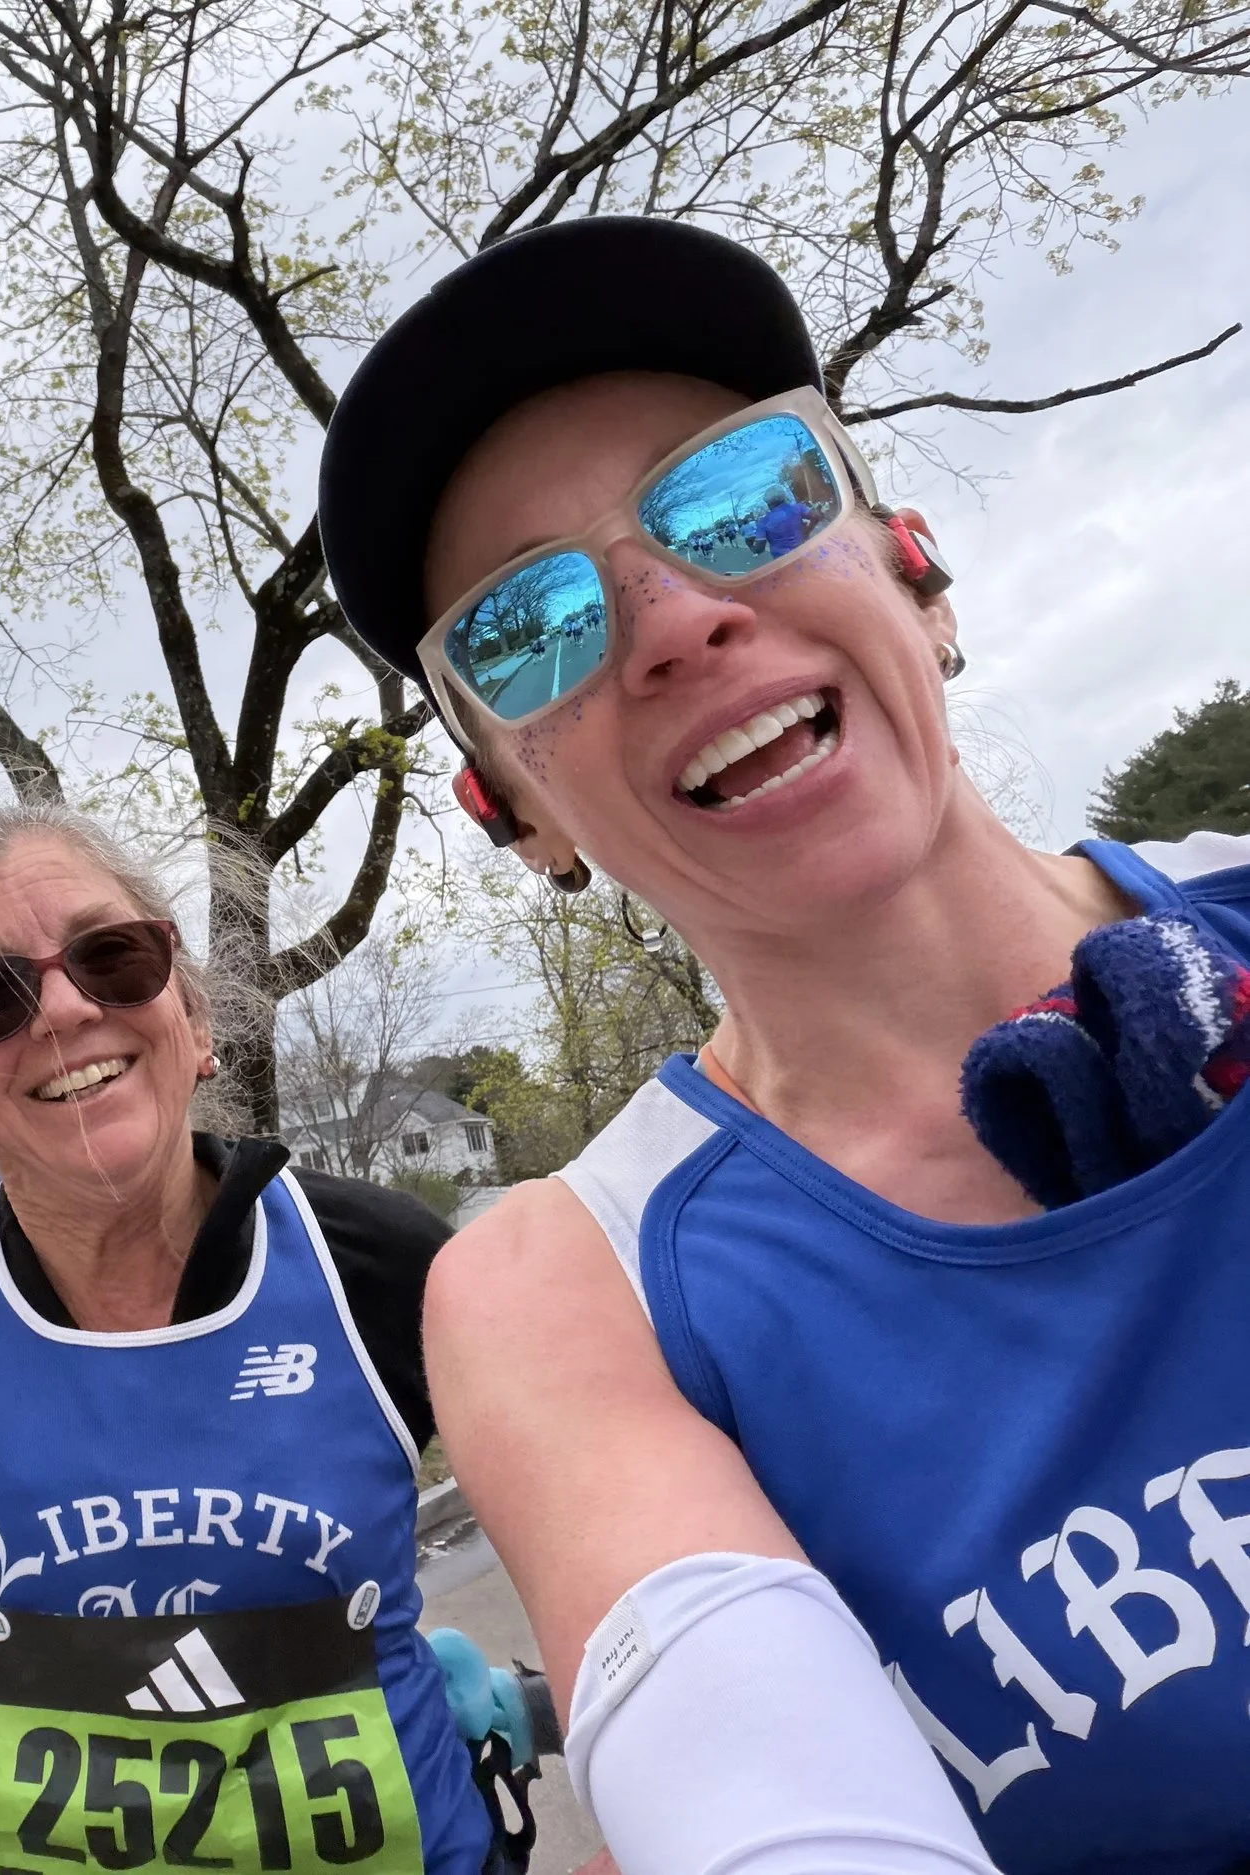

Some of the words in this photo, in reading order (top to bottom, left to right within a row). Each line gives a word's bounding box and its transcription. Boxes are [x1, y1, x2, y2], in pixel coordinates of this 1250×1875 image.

[230, 1343, 317, 1400] NB
[618, 1627, 634, 1646] run
[602, 1647, 618, 1669] free
[617, 1644, 638, 1668] born
[14, 1714, 383, 1870] 25215
